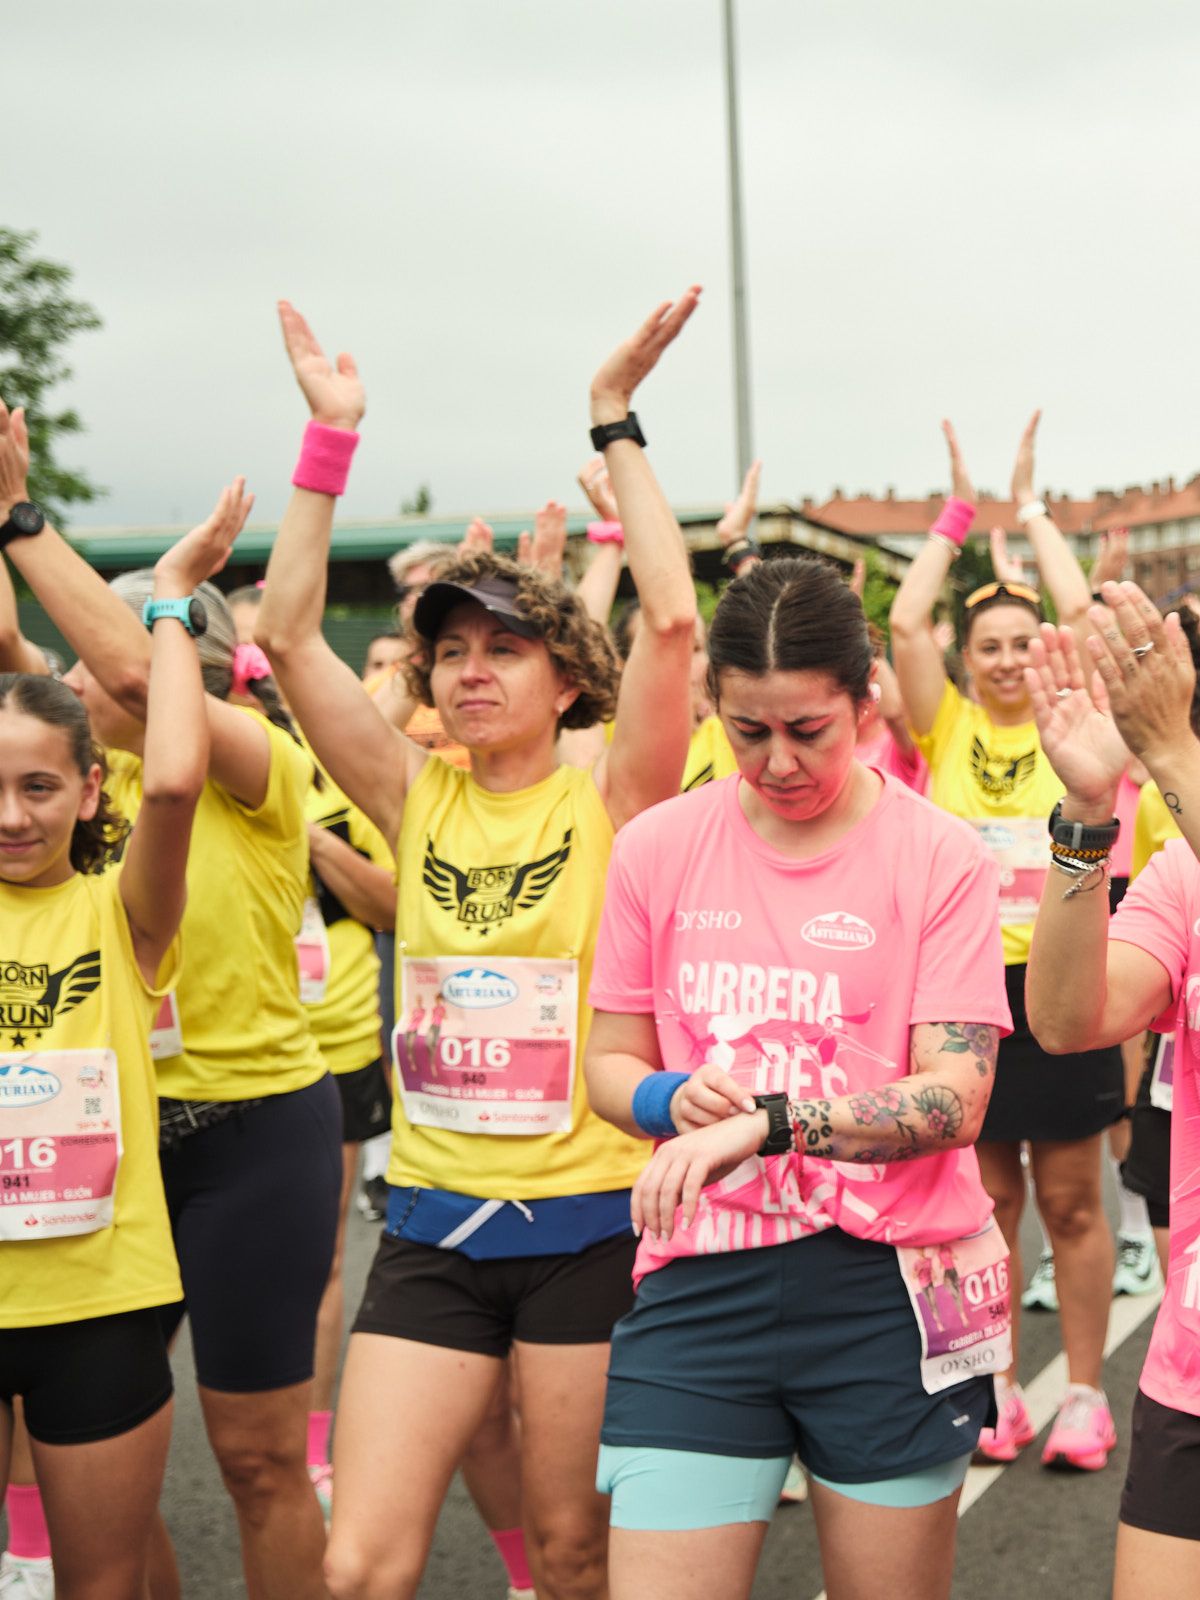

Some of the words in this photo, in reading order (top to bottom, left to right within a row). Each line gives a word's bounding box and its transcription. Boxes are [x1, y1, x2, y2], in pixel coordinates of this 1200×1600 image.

[0, 966, 44, 985] ORN
[679, 960, 843, 1029] CARRERA
[440, 1038, 511, 1068] 016
[462, 1072, 486, 1086] 940
[0, 1138, 57, 1168] 16
[3, 1175, 30, 1189] 941
[964, 1261, 1009, 1306] 016
[941, 1350, 995, 1375] OYSHO
